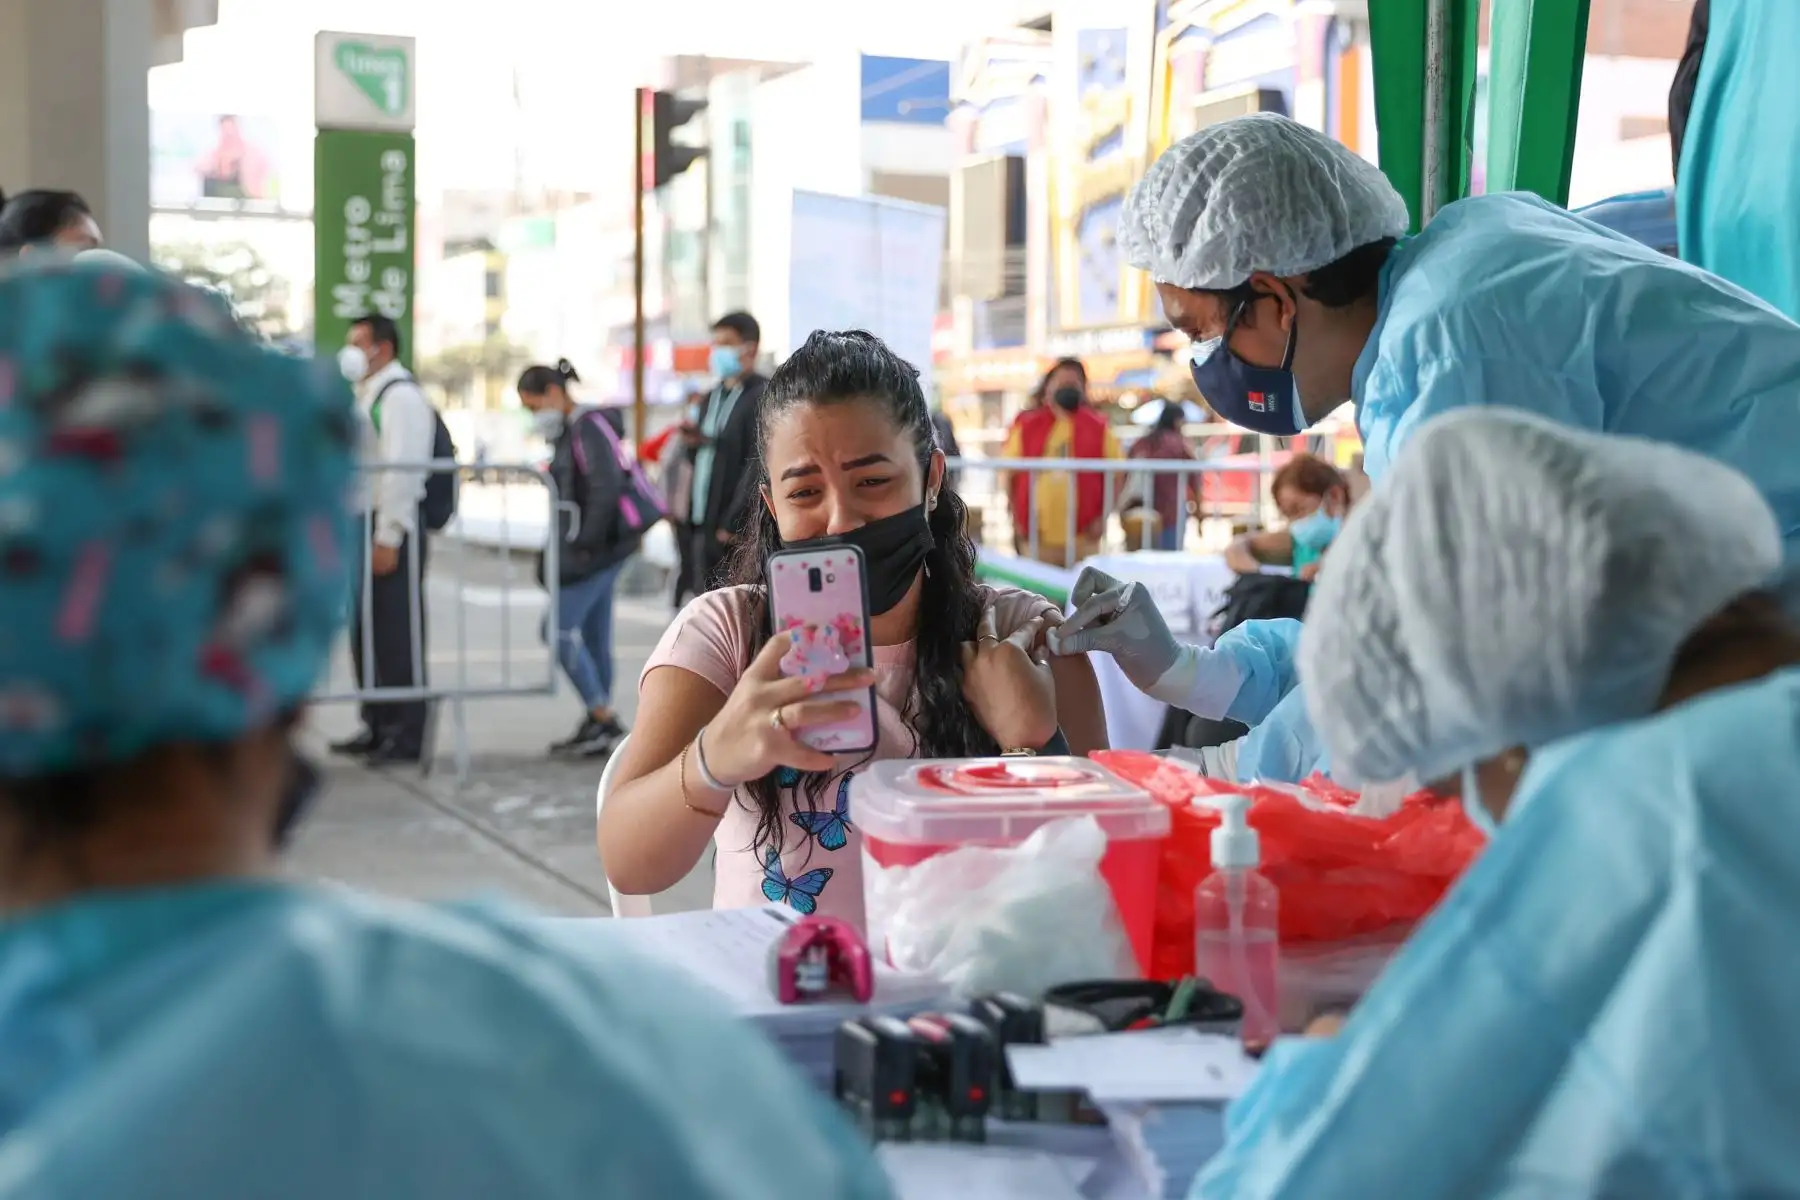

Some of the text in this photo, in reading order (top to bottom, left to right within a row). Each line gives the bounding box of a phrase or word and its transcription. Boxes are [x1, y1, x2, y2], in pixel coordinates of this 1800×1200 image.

[331, 194, 372, 319] Metro
[371, 148, 408, 320] de Lima
